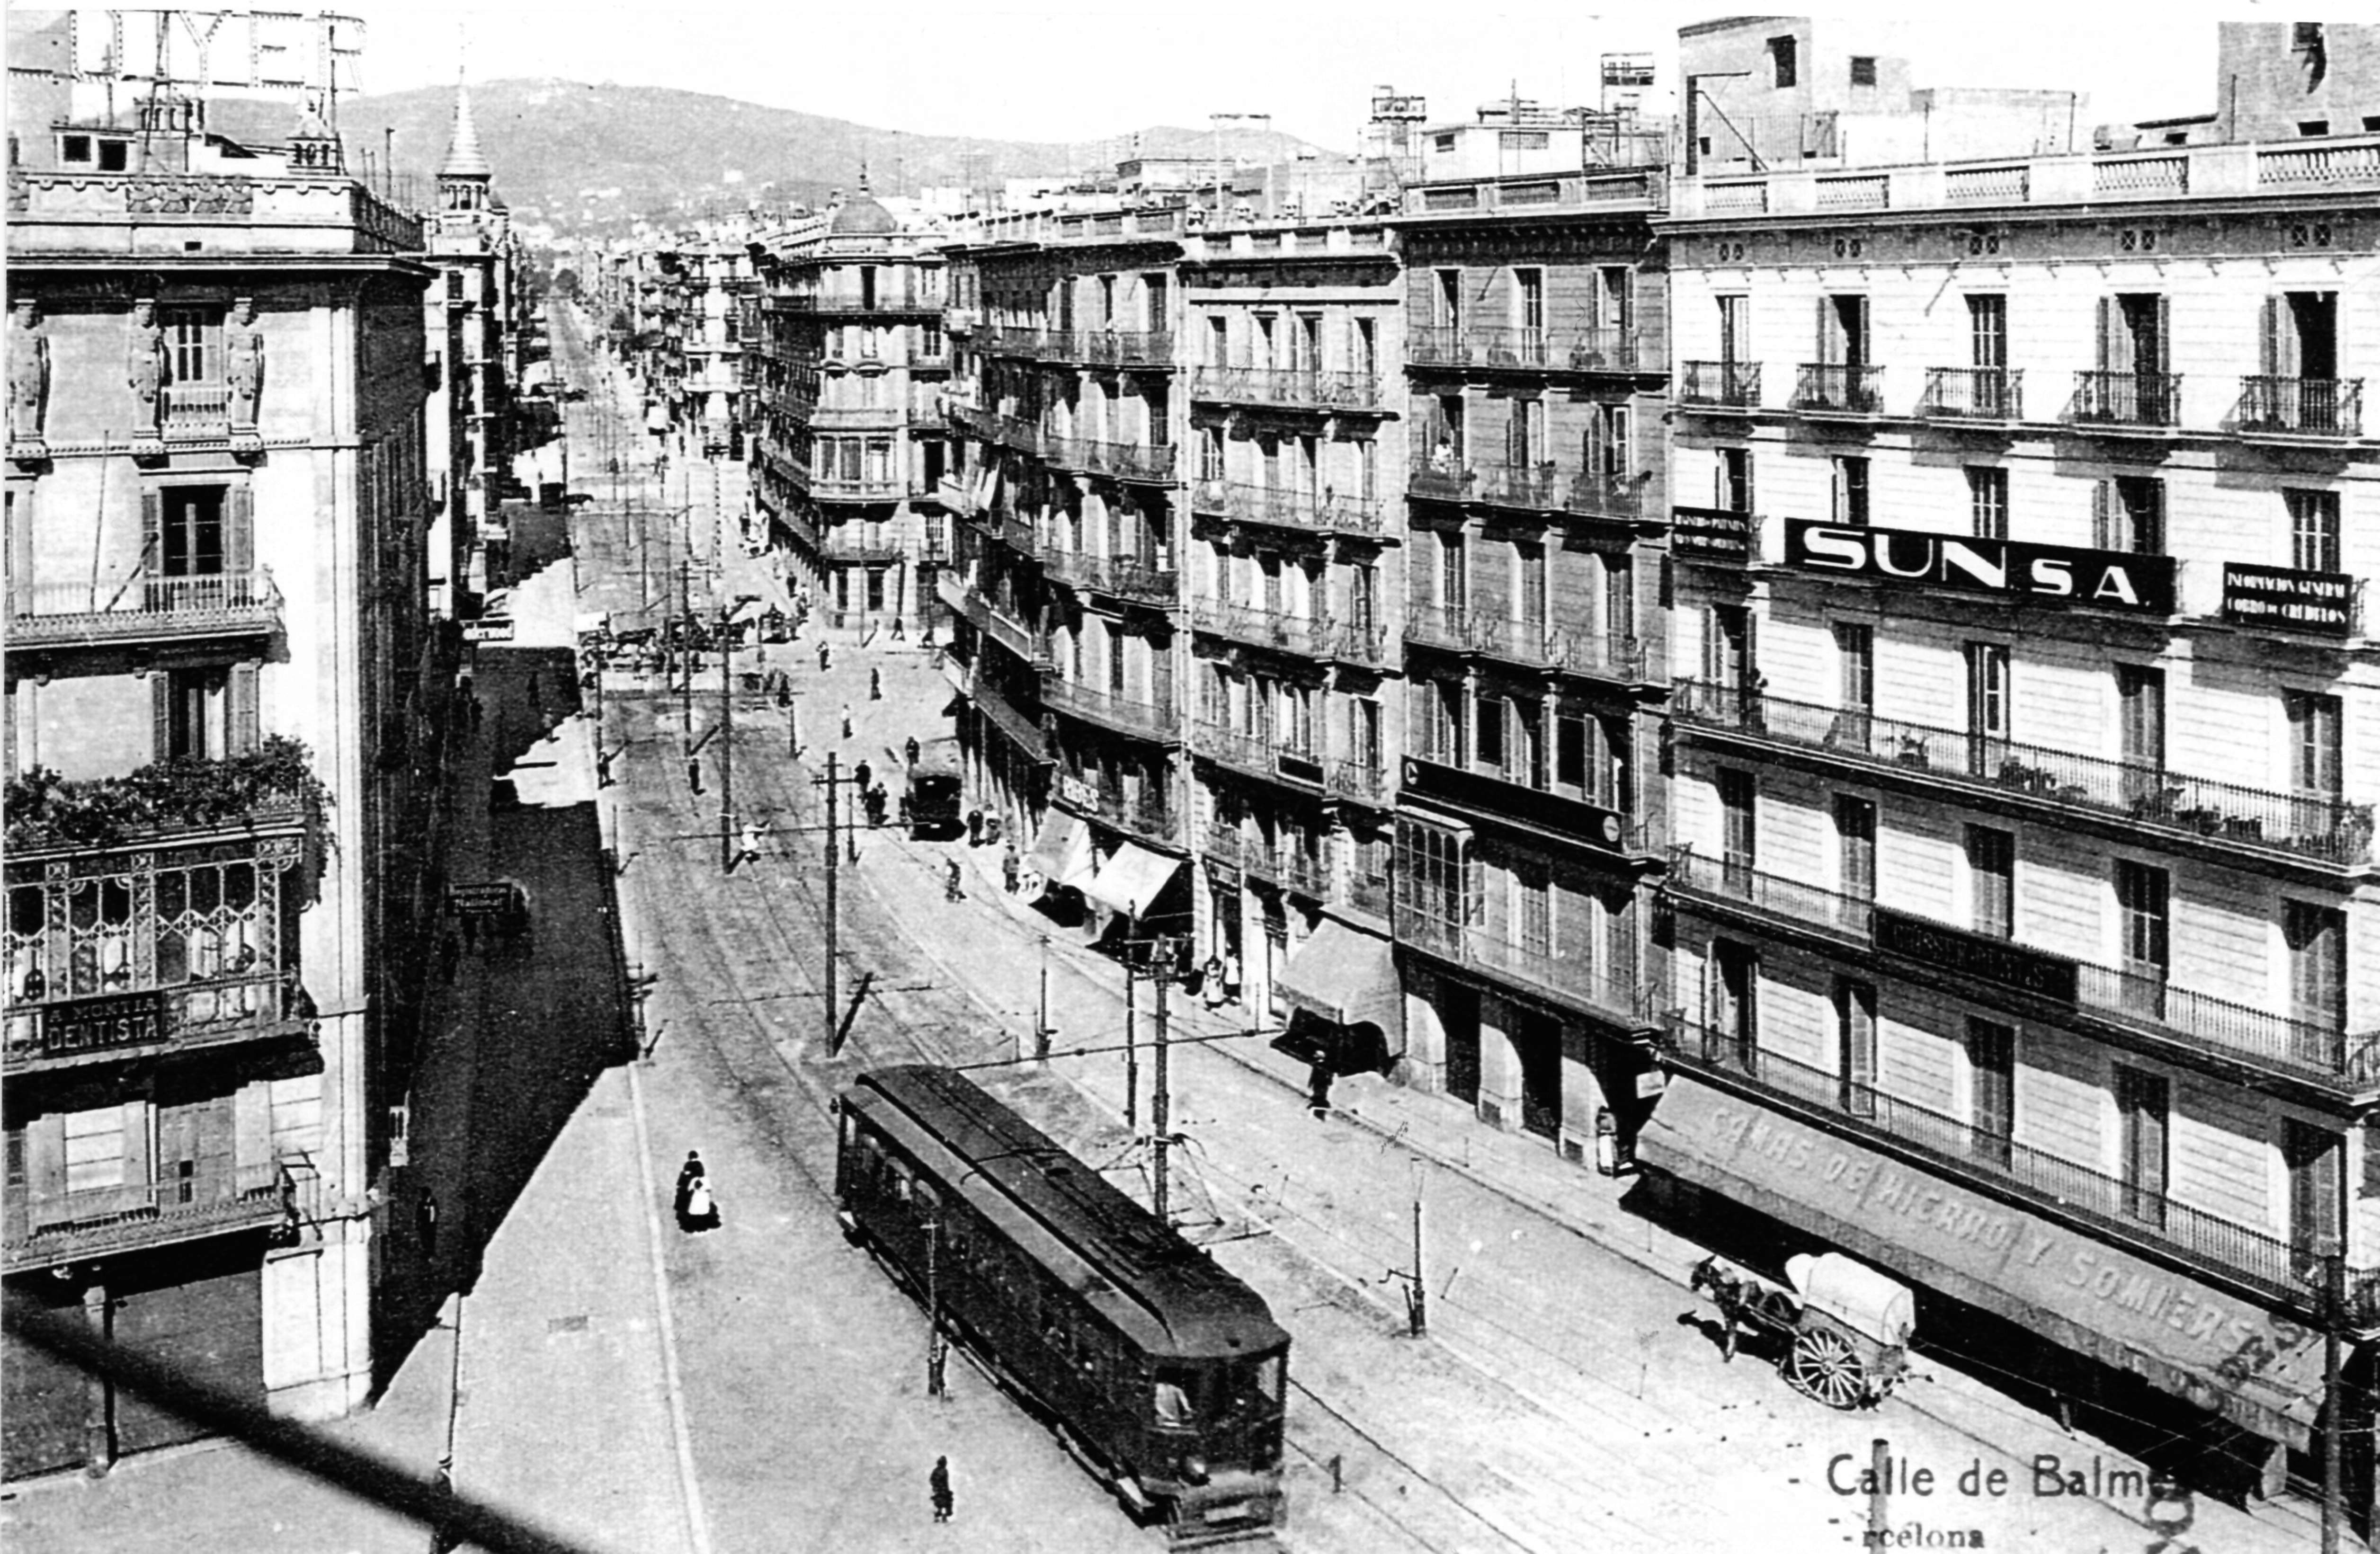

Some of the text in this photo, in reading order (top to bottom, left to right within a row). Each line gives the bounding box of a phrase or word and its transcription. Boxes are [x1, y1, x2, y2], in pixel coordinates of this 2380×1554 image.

[48, 1014, 158, 1050] DENTISTA
[1824, 1152, 1874, 1193] DE
[2028, 1234, 2057, 1269] Y
